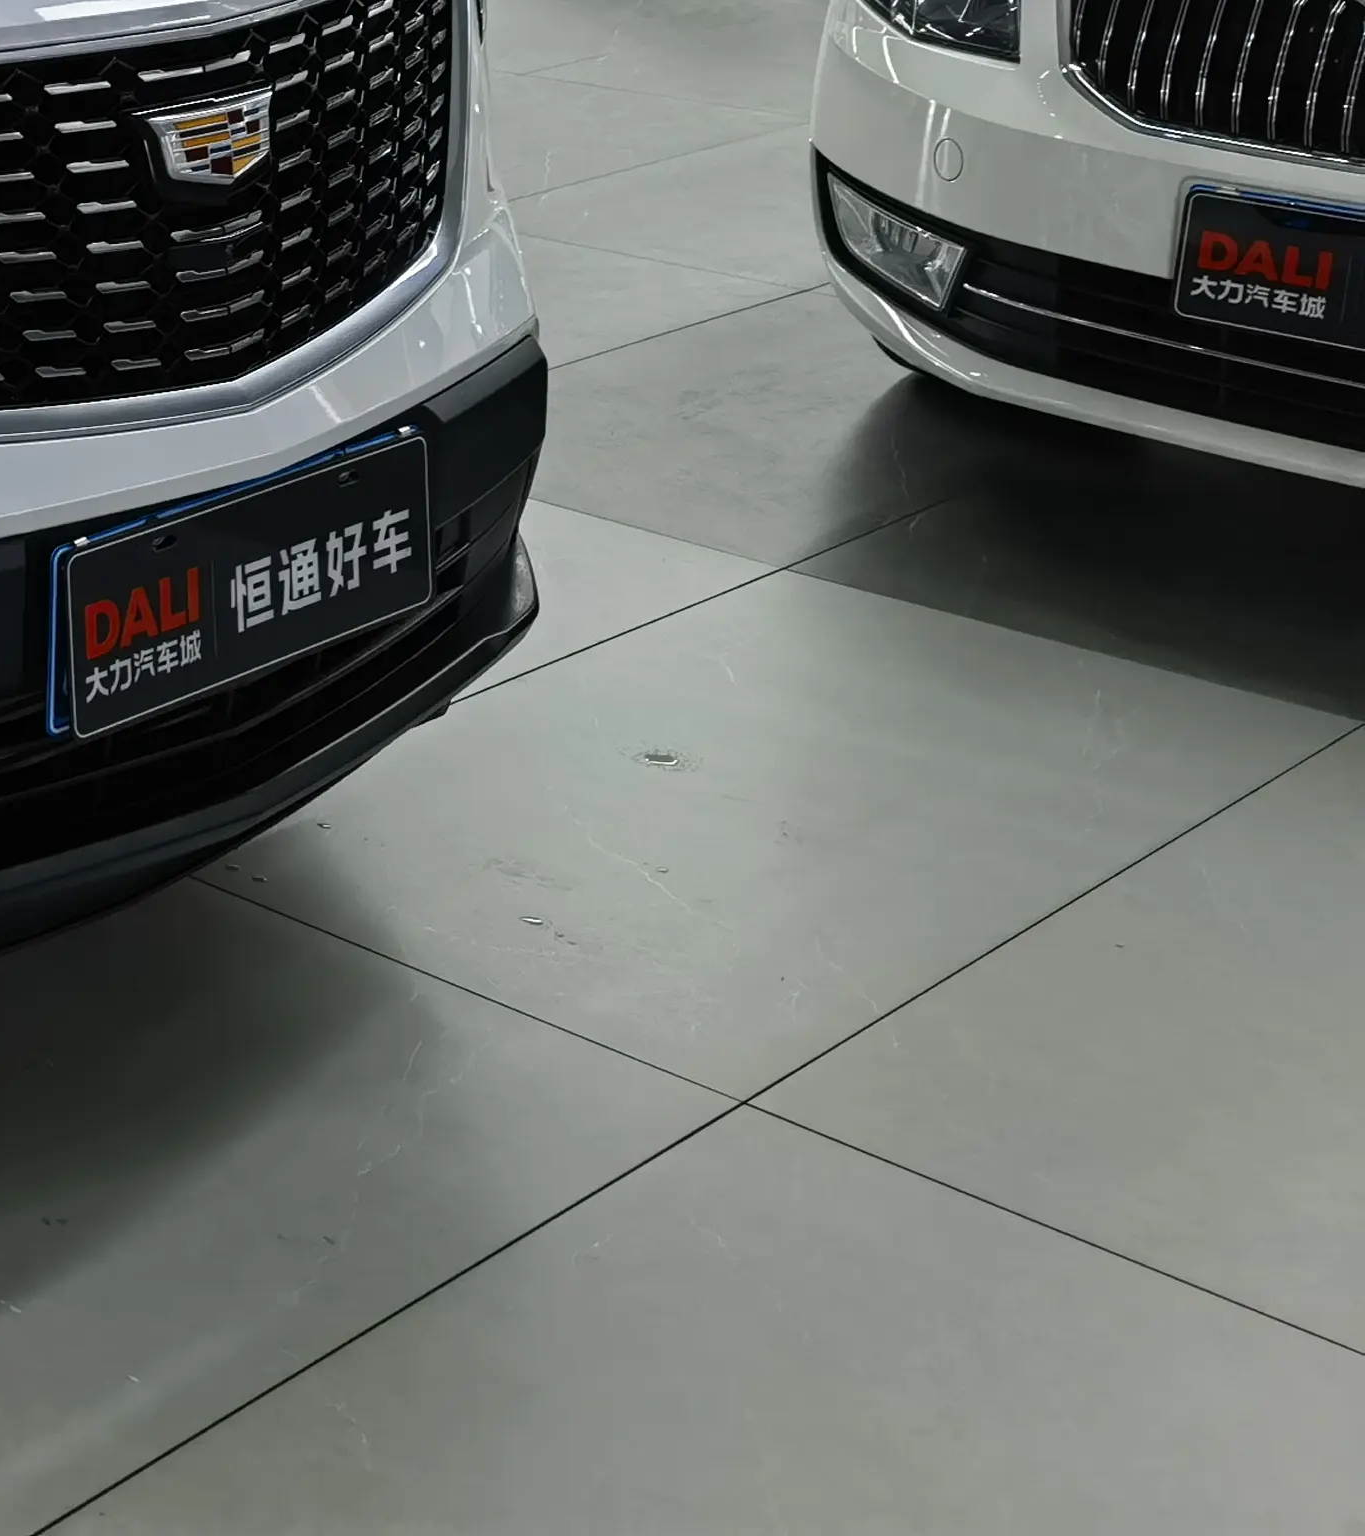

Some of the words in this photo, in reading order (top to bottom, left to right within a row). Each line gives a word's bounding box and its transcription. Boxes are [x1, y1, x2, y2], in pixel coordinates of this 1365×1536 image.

[1190, 274, 1327, 320] 大力汽车城
[1197, 230, 1334, 291] DALI
[229, 509, 413, 633] 恒通好车
[83, 567, 200, 661] DALI
[83, 629, 203, 704] 大力汽车城
